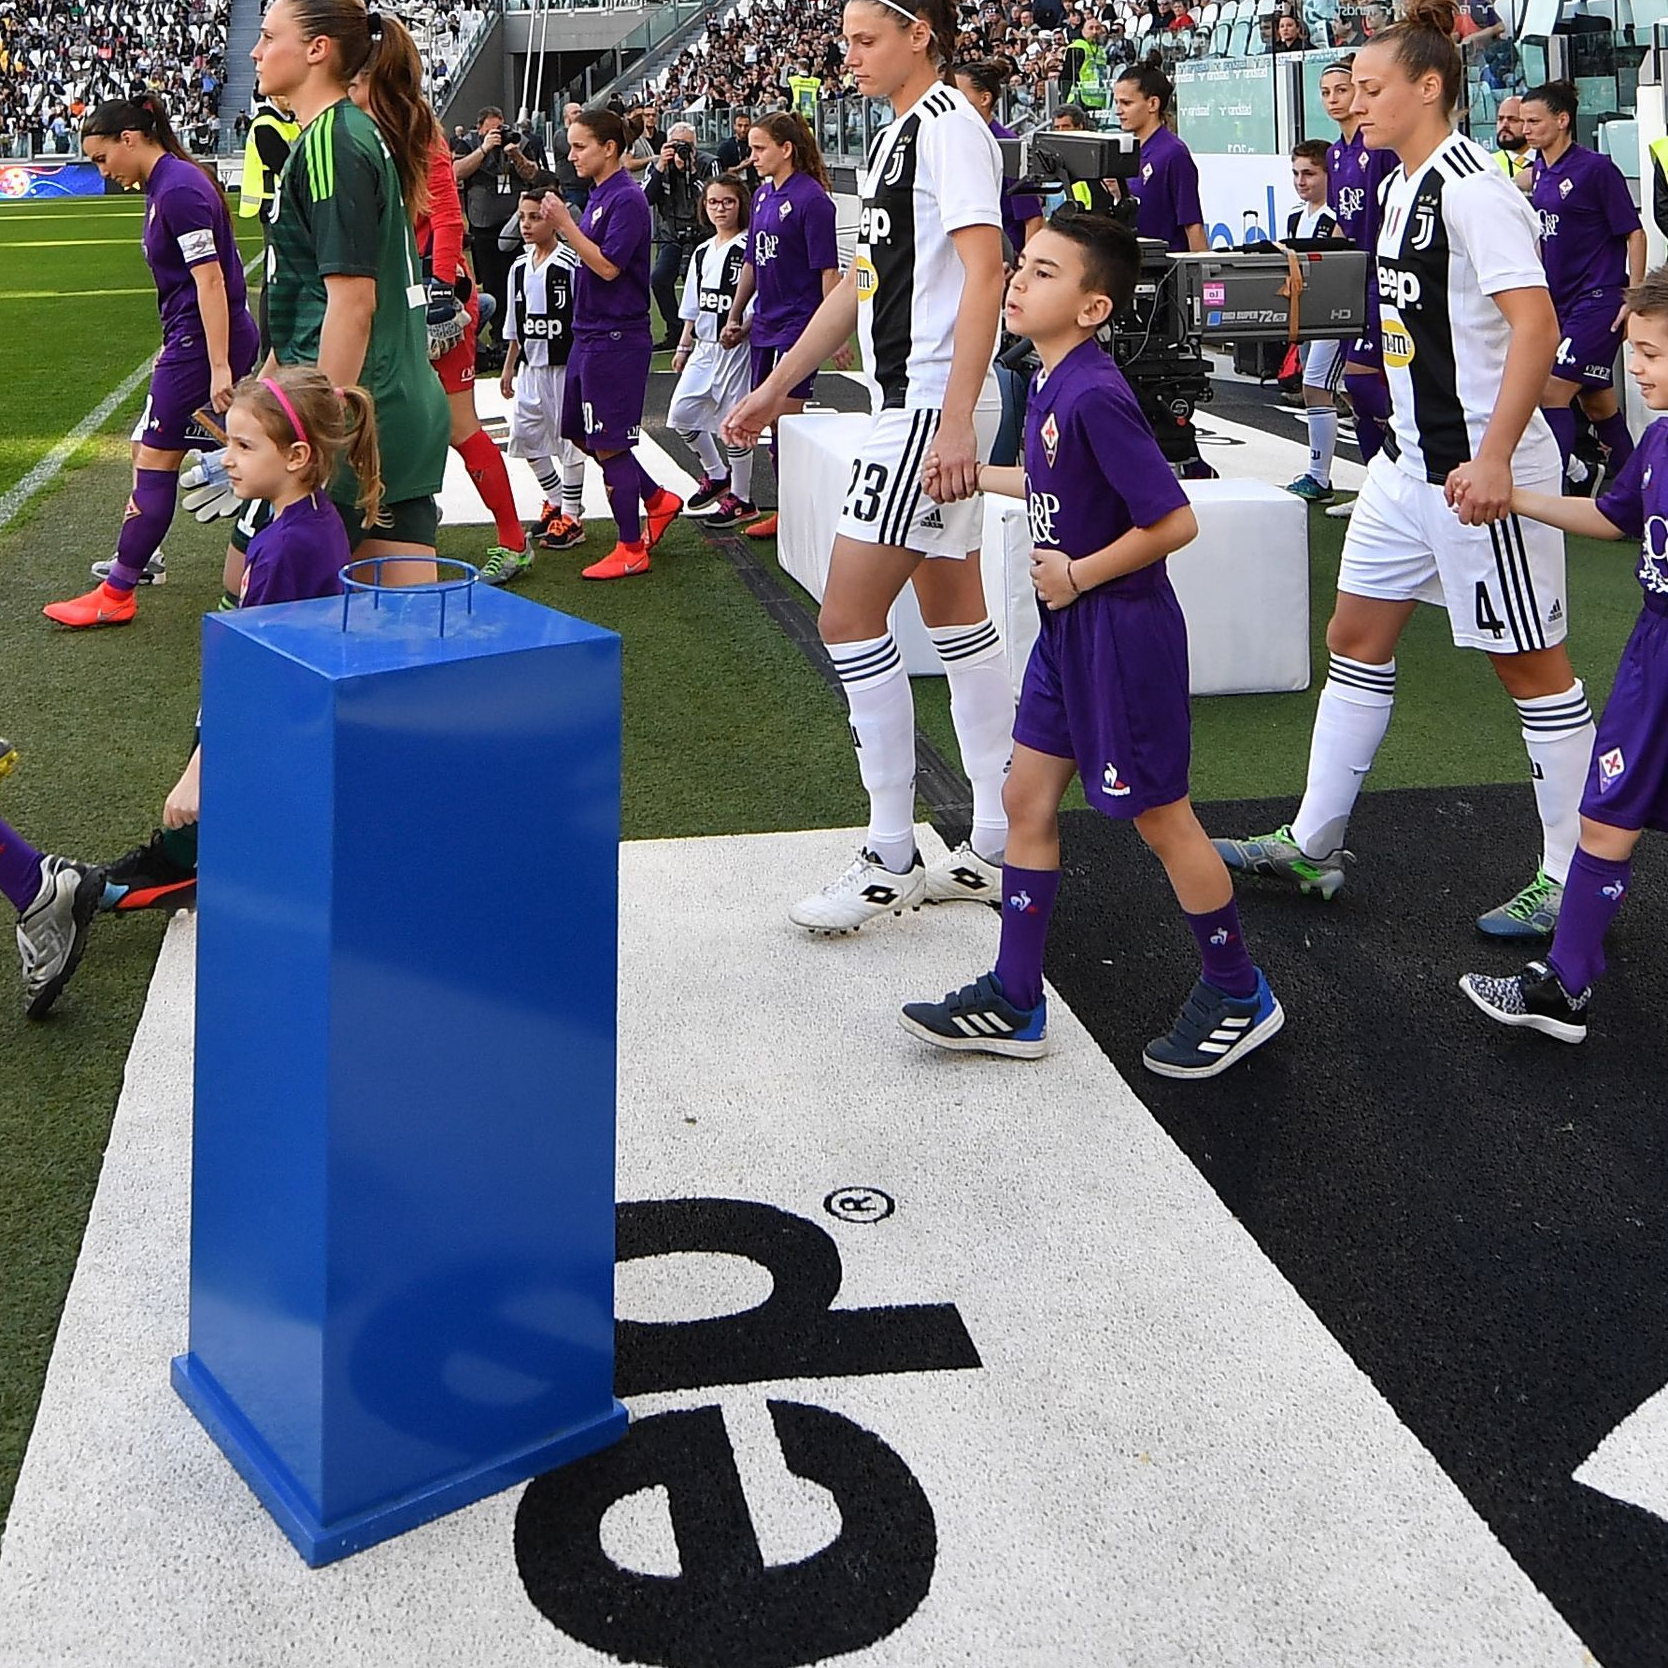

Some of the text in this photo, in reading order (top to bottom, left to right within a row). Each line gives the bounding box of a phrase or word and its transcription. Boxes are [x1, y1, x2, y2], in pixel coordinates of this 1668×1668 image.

[700, 291, 732, 314] eep
[1330, 308, 1351, 320] HD
[1258, 310, 1273, 323] 72
[523, 317, 563, 340] eep
[1474, 580, 1505, 641] 4
